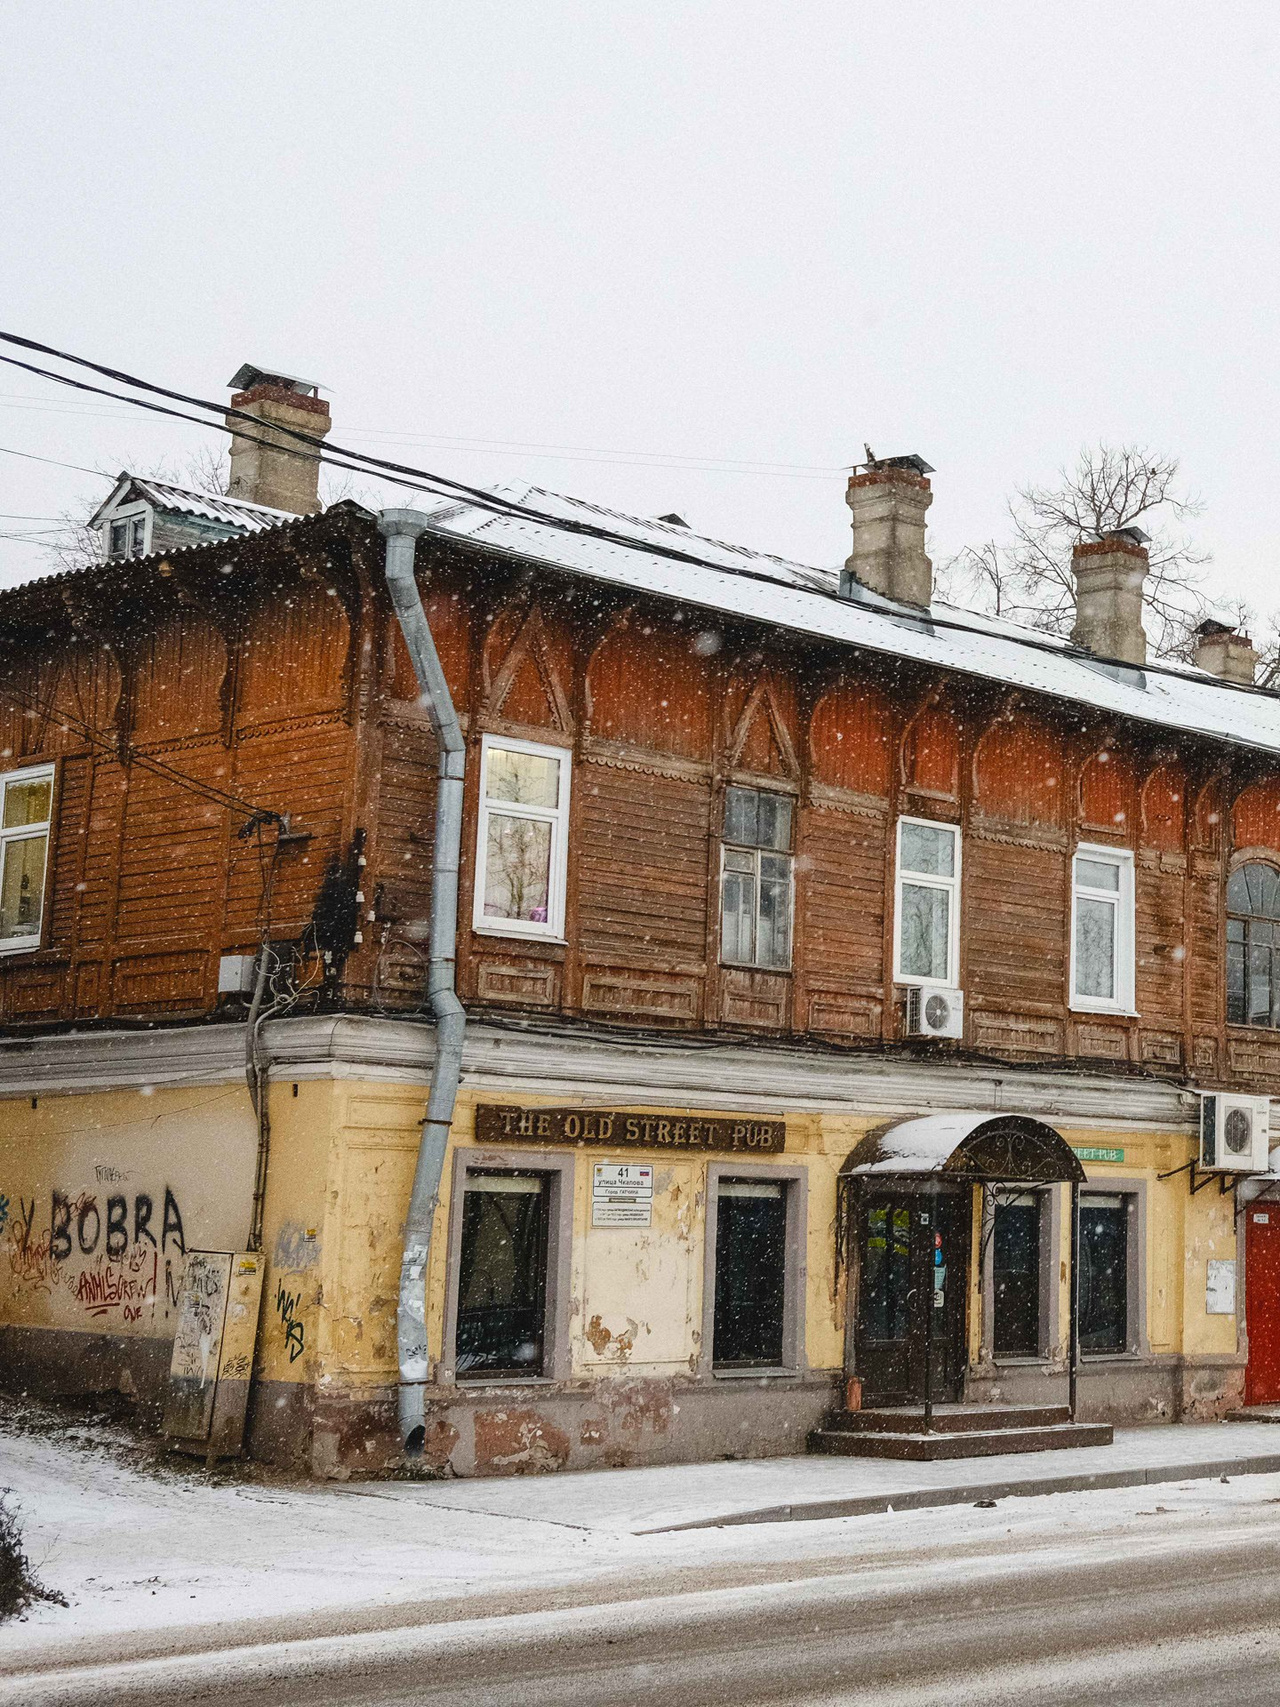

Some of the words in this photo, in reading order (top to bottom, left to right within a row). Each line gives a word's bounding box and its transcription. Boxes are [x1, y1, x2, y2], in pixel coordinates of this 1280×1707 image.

[500, 1111, 551, 1137] THE
[565, 1114, 613, 1139] OLD
[626, 1118, 720, 1145] STREET
[732, 1124, 774, 1148] PUB
[1098, 1148, 1118, 1161] PUB
[617, 1167, 629, 1178] 41
